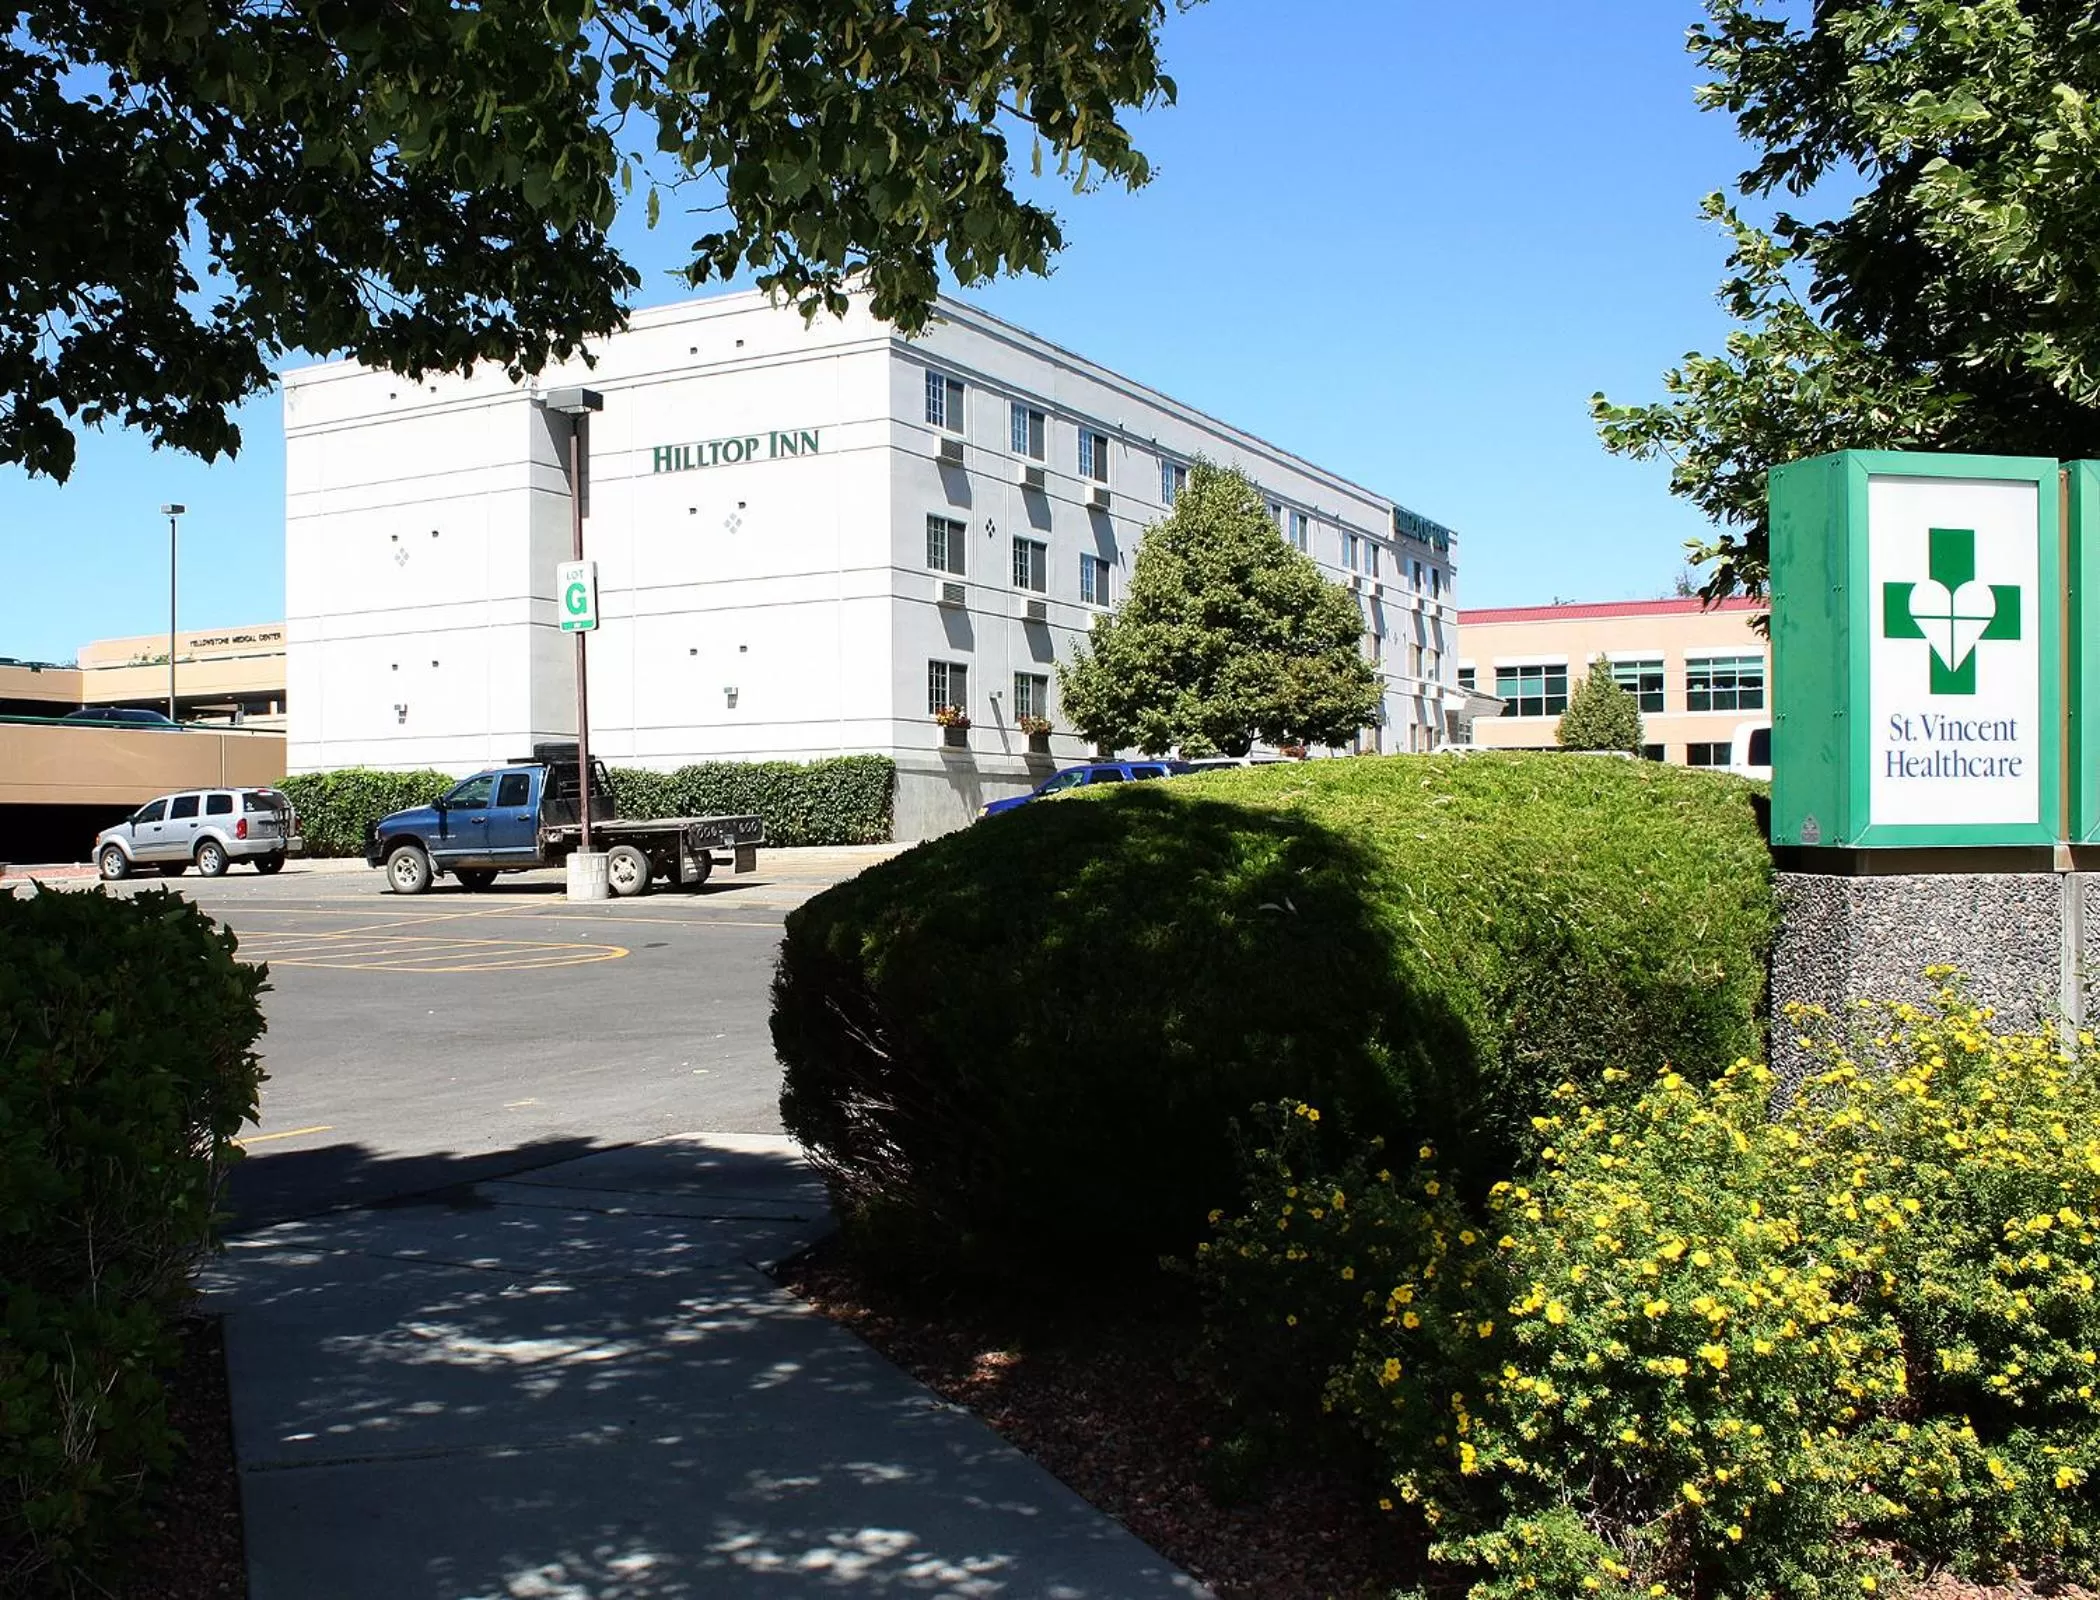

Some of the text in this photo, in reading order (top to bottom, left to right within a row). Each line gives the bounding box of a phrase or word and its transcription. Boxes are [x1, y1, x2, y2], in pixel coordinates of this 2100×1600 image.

[653, 430, 819, 473] HILLTOP INN
[566, 569, 583, 580] LOT
[566, 583, 587, 614] G
[190, 632, 281, 647] YELLOWSTONE MEDICAL CENTER
[1889, 713, 2018, 742] St. Vincent
[1884, 749, 2023, 778] Healthcare
